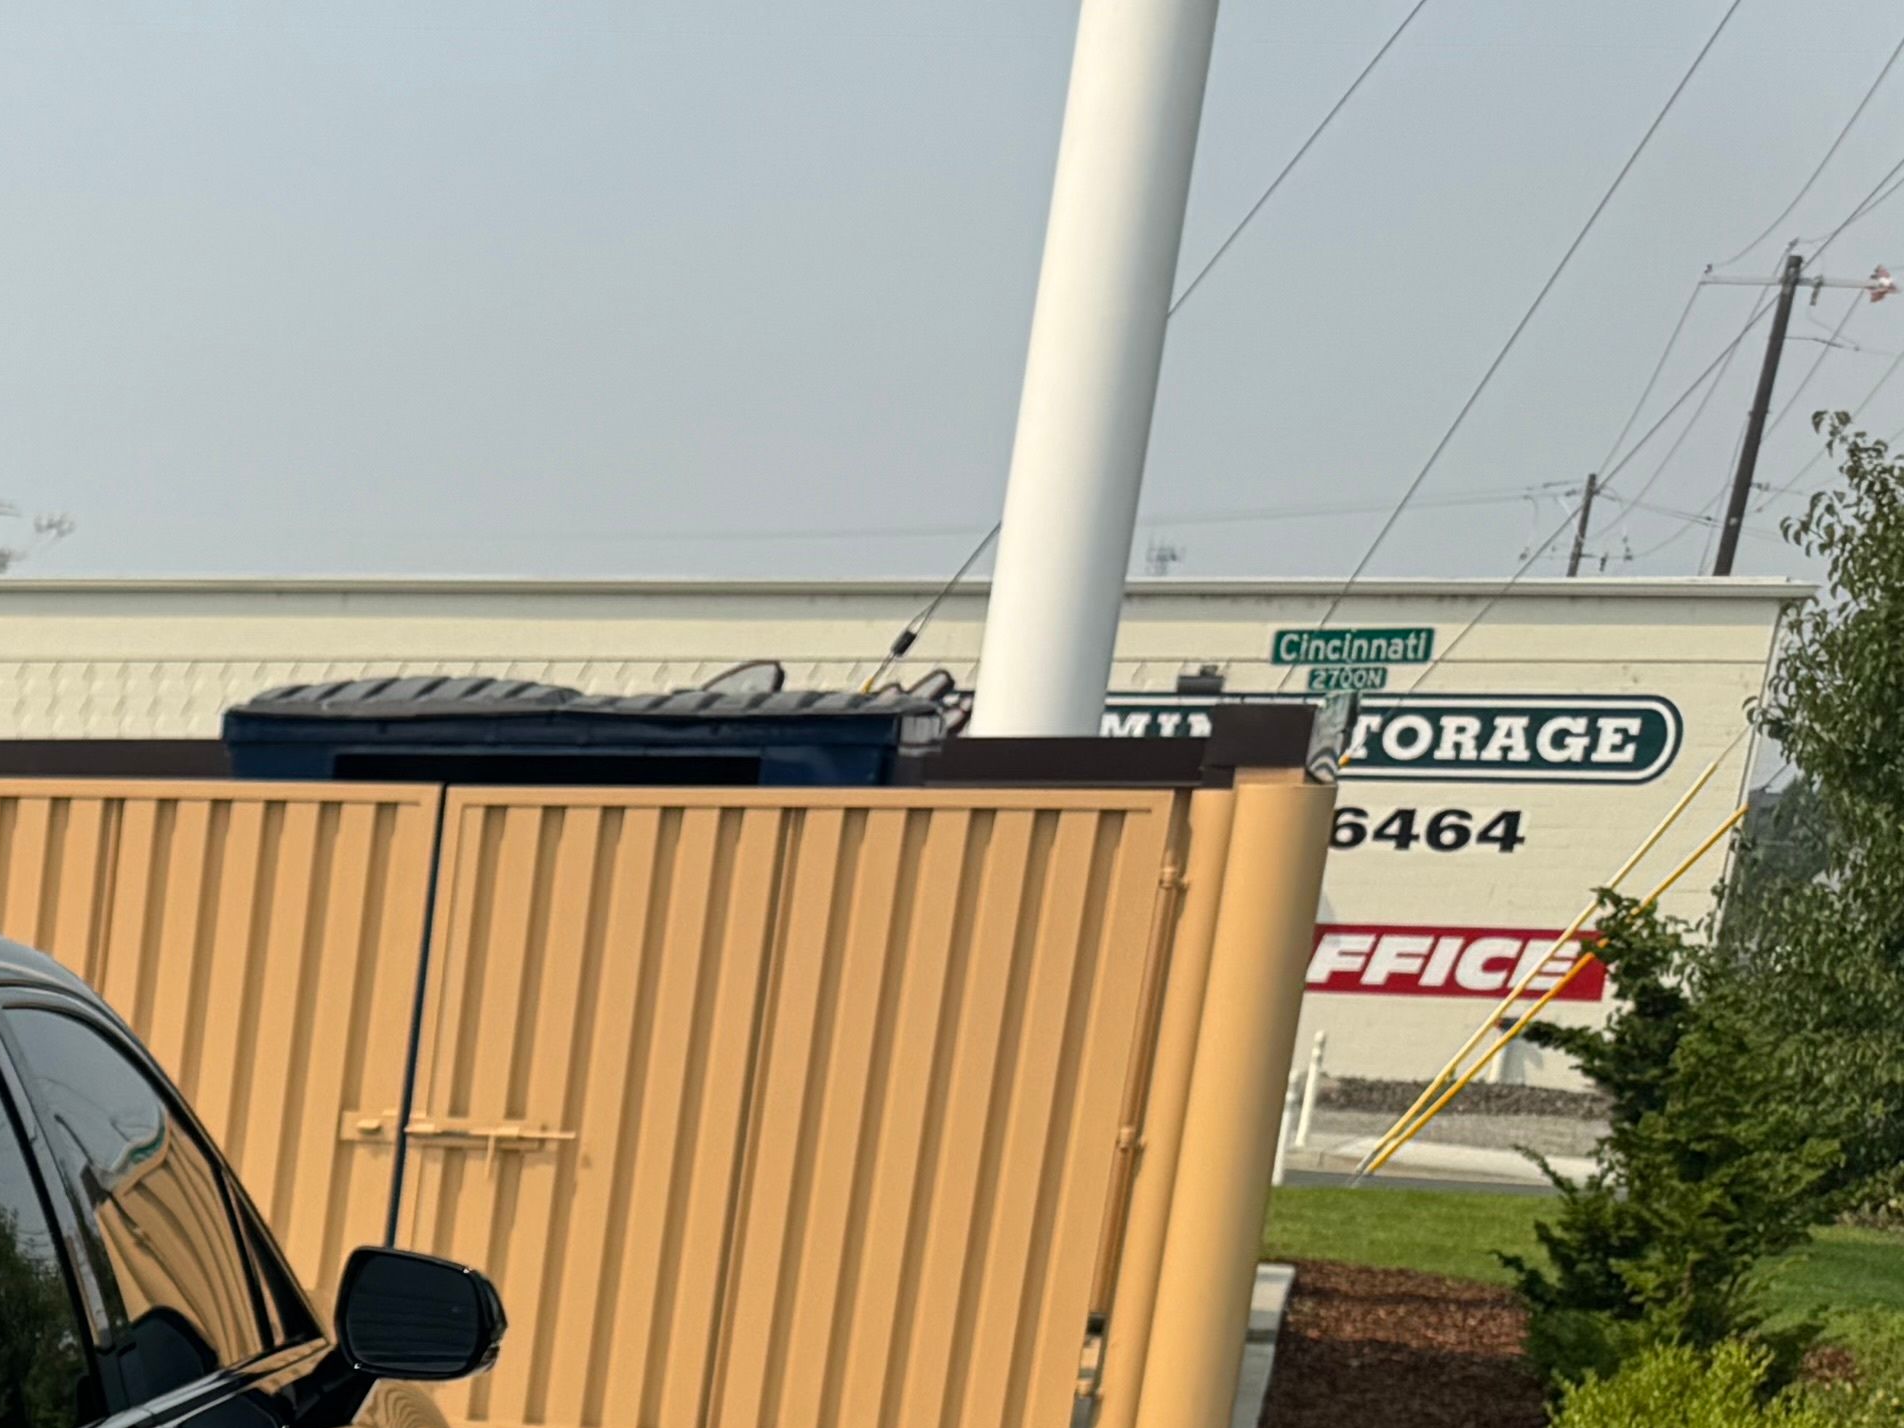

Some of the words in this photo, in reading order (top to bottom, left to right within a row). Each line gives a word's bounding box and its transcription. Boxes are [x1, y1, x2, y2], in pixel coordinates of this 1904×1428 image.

[1280, 631, 1426, 662] Cincinnati
[1313, 669, 1382, 690] 2700N
[1346, 713, 1642, 763] TORAGE
[1304, 932, 1583, 991] FFICE
